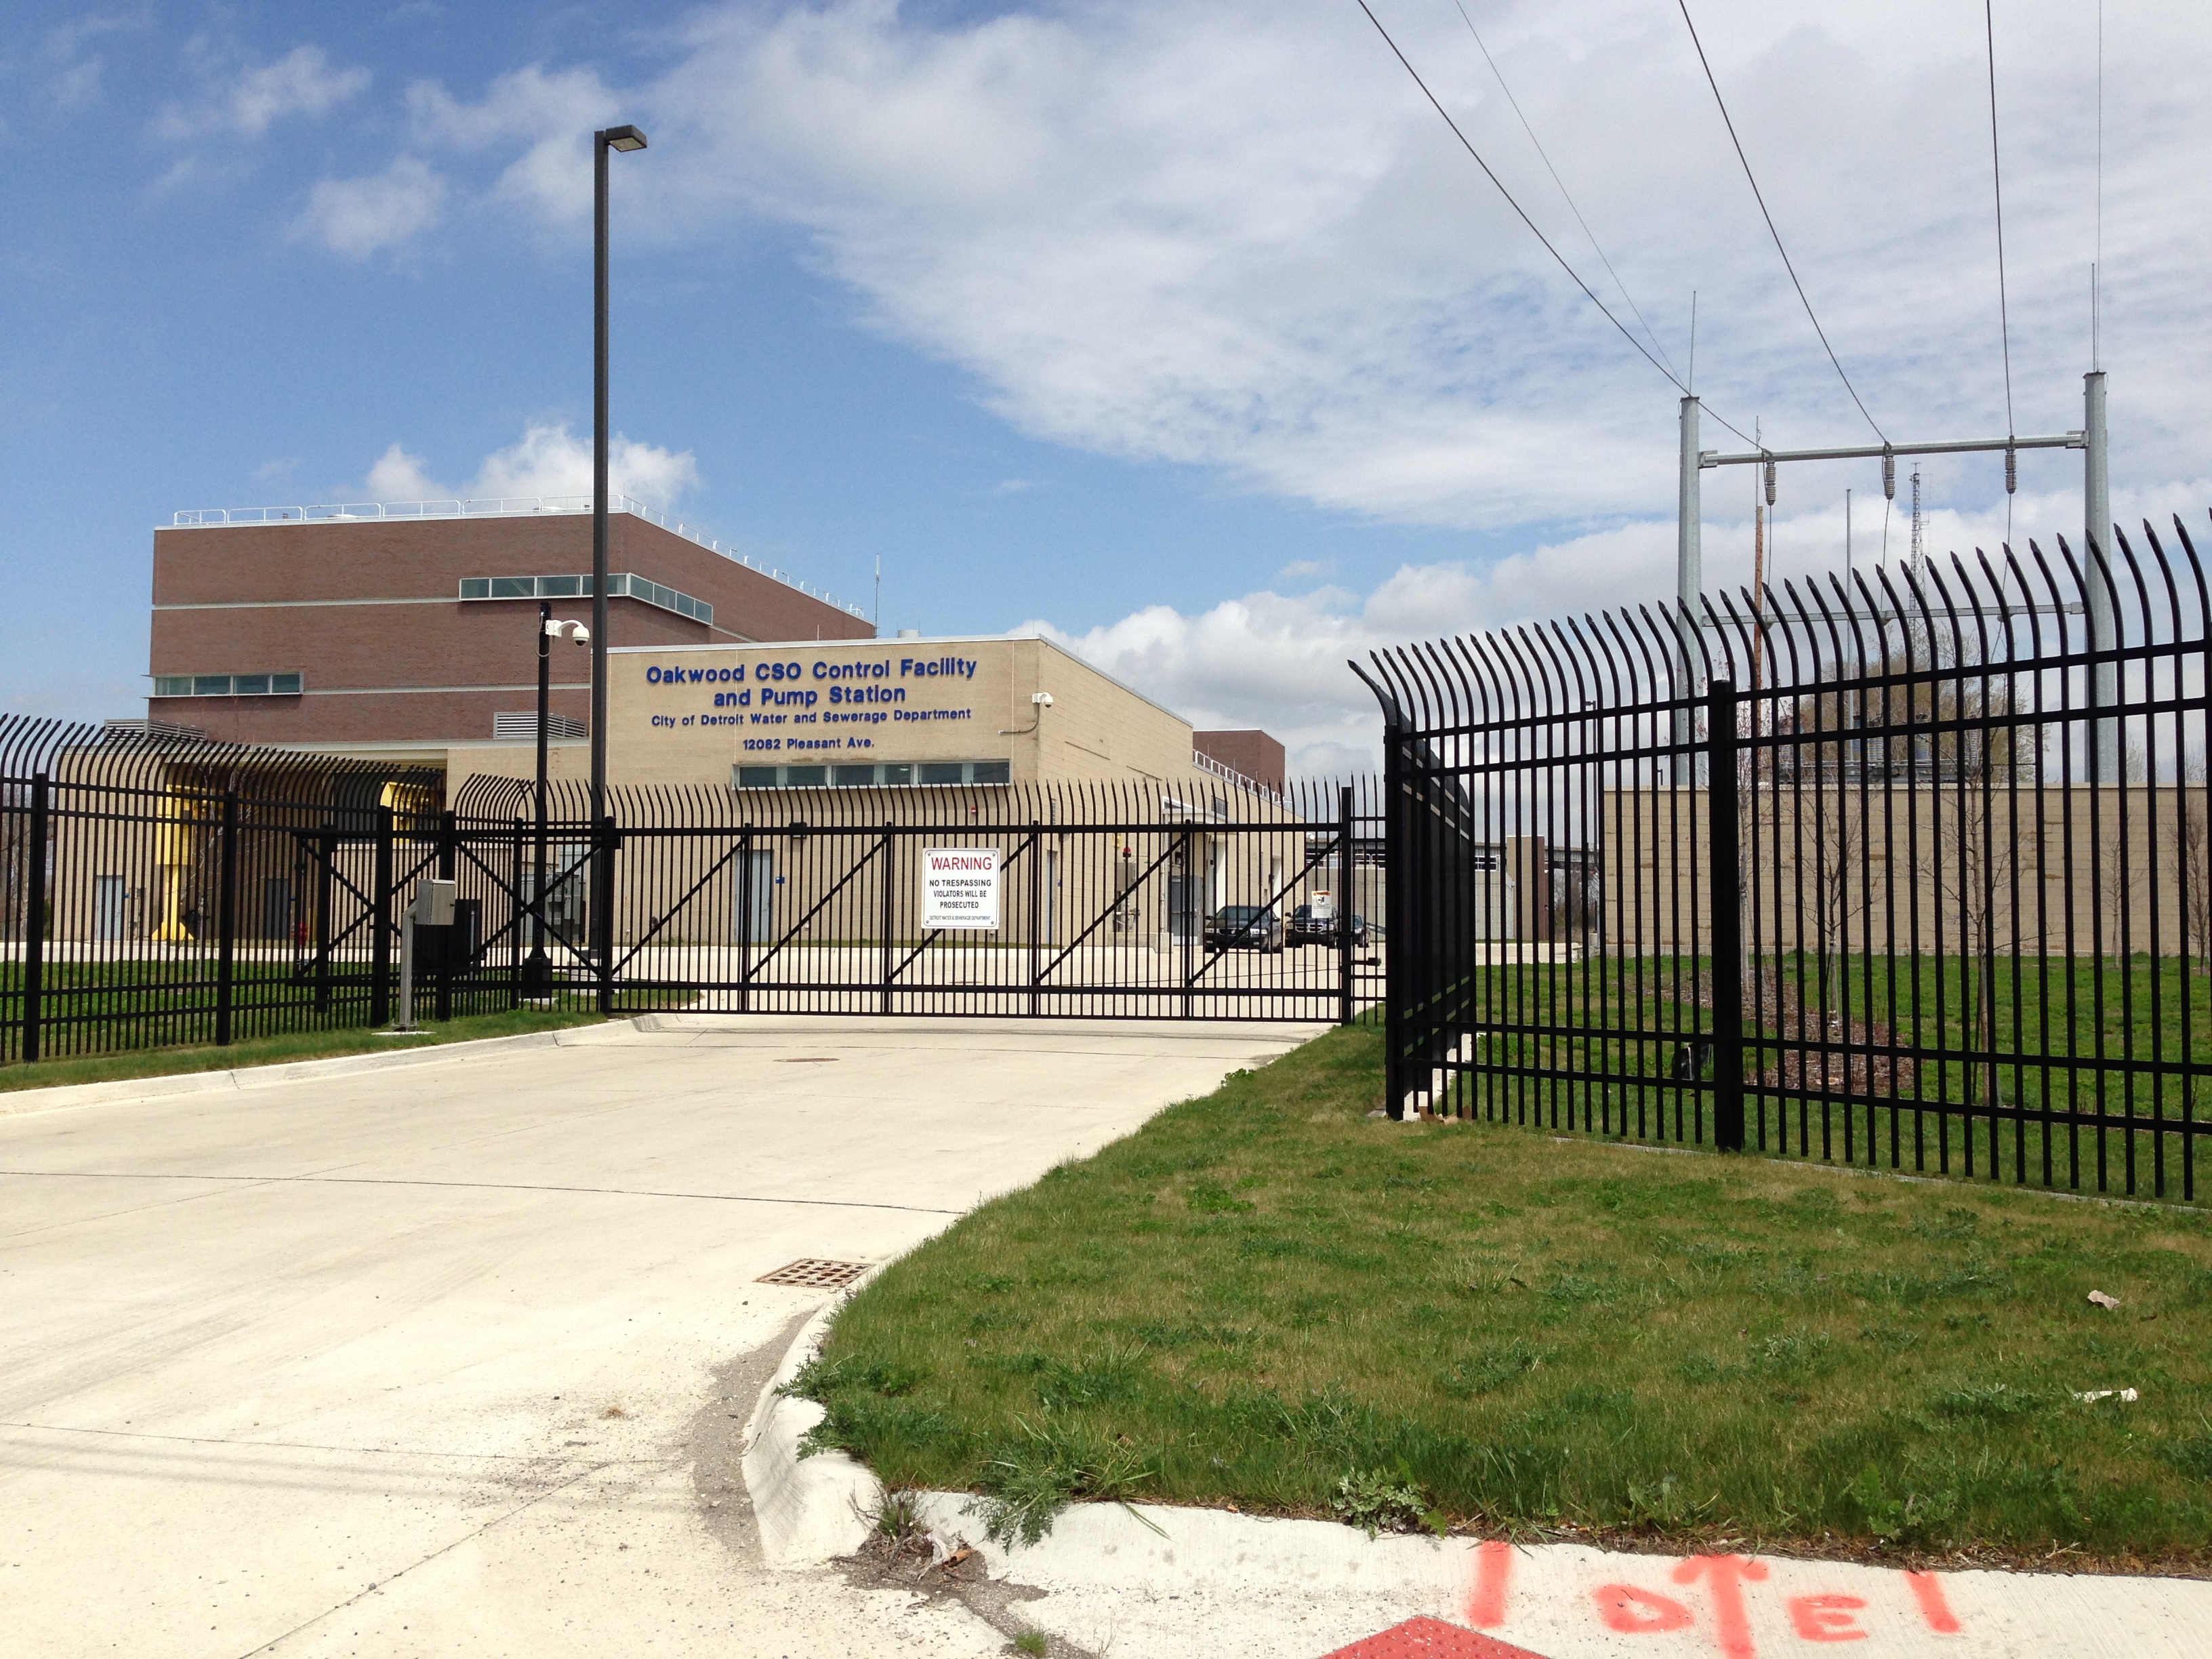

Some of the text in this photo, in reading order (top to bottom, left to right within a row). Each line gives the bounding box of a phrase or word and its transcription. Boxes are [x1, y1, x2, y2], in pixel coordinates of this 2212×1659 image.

[647, 657, 977, 683] Oakwood CSO Control Facility
[714, 684, 906, 708] and Pump Station
[651, 708, 971, 729] City of Detroit Water and Sewerage Department
[743, 737, 875, 750] 12082 Pleasant Ave.
[931, 857, 992, 870] WARNING
[939, 901, 979, 909] PROSECUTED
